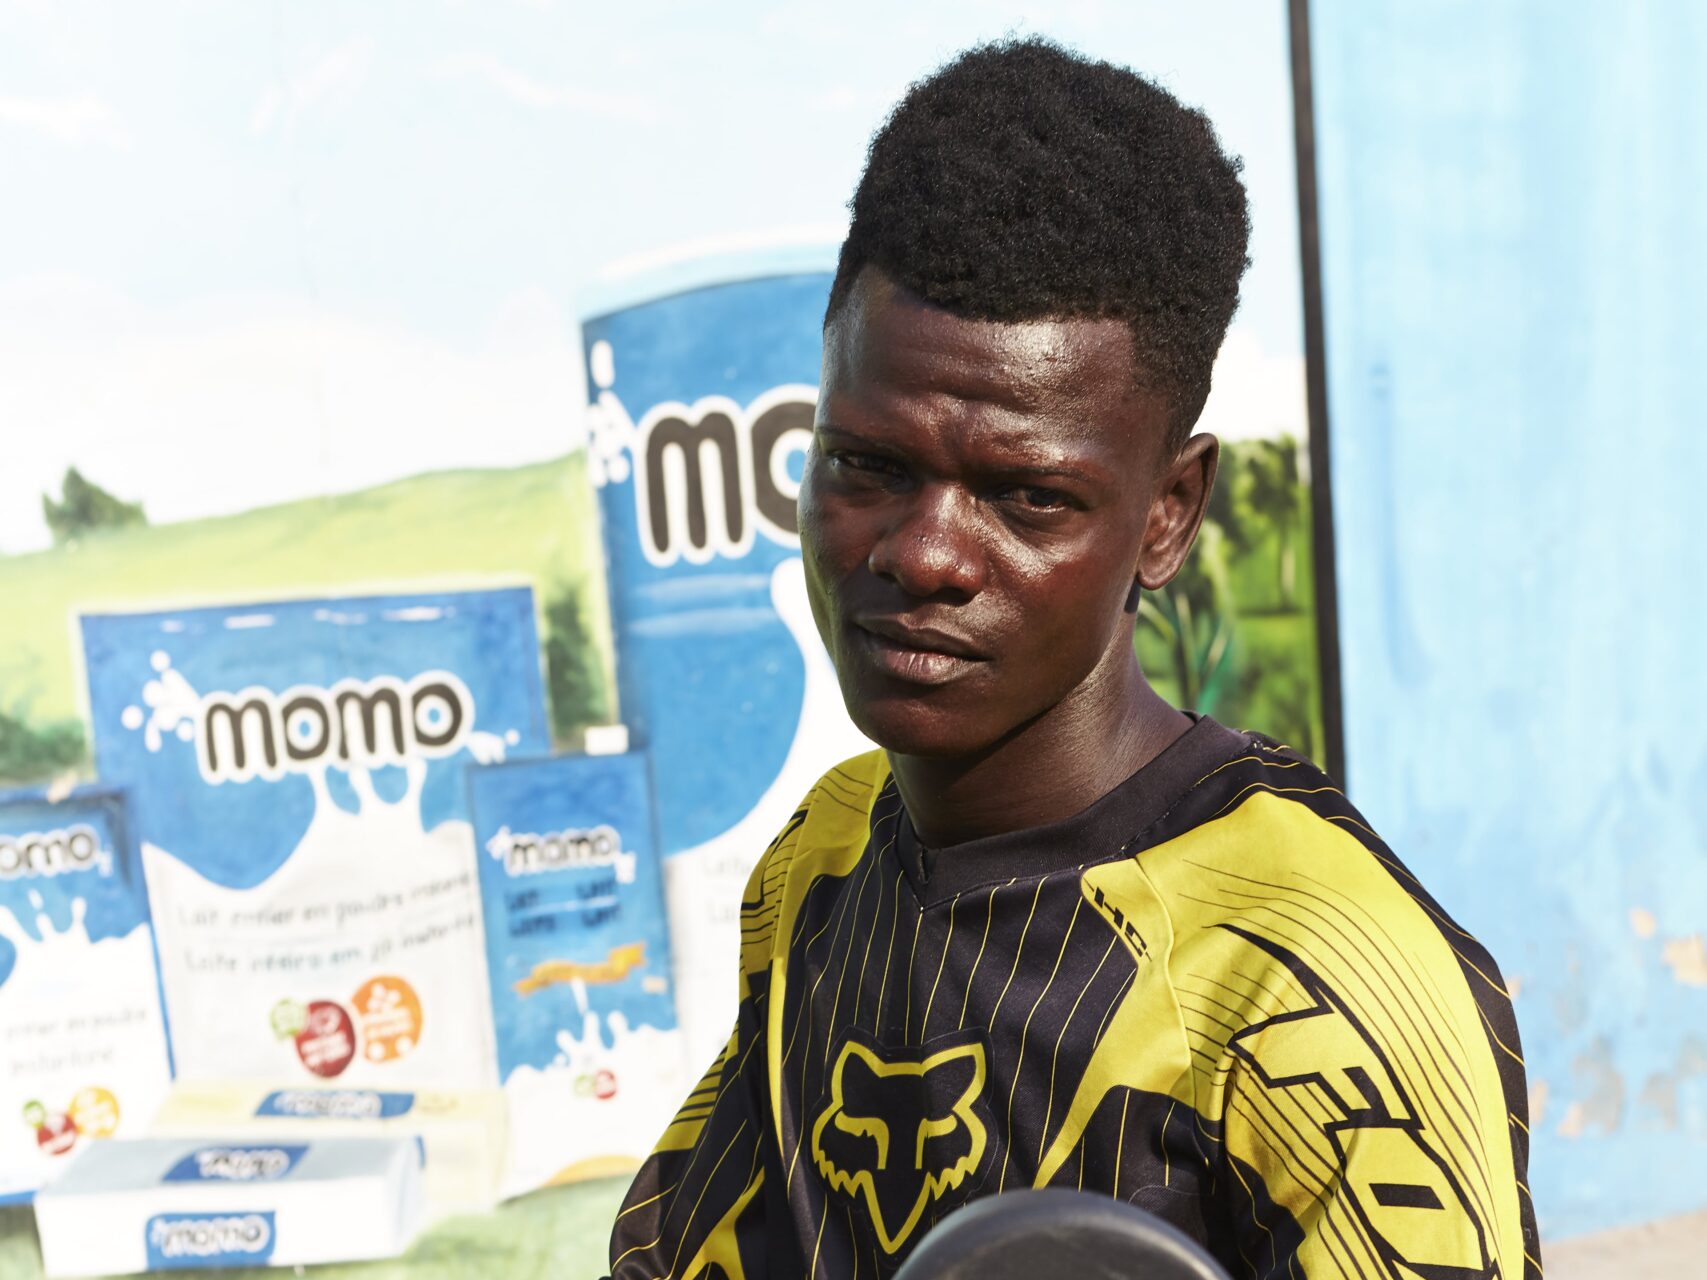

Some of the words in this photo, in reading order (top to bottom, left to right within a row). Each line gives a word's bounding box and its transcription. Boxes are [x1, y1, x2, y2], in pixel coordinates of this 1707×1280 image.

[203, 682, 465, 773] momo
[0, 829, 97, 874] omo
[508, 830, 616, 874] momo
[163, 1217, 267, 1256] momo
